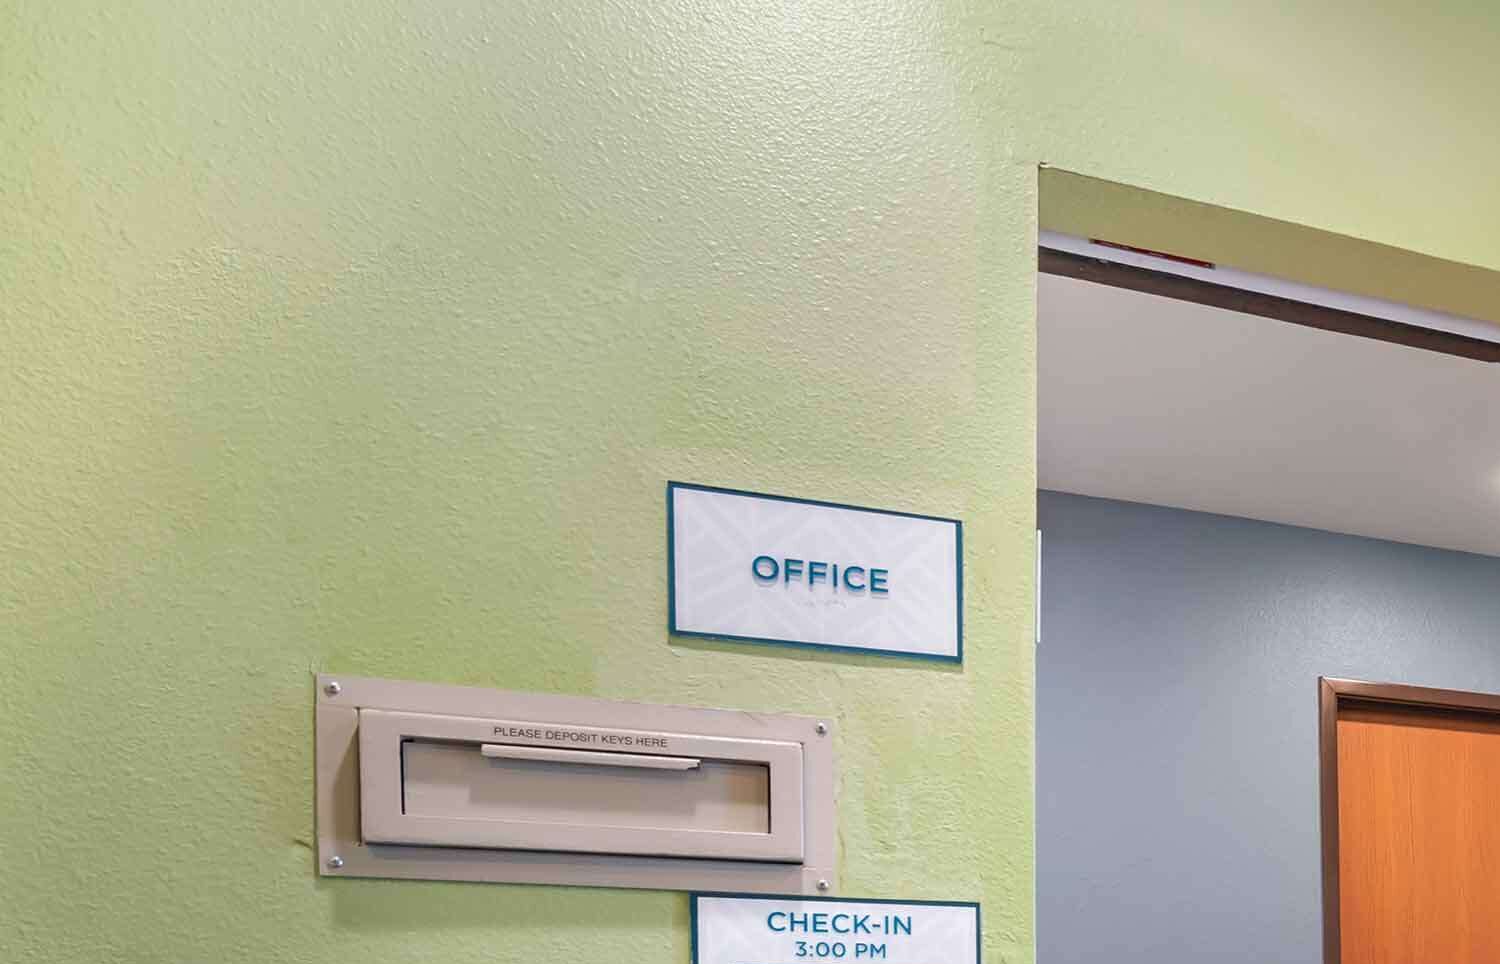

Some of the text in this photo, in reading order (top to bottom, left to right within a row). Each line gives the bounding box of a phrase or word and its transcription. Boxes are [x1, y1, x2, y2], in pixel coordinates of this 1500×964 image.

[752, 555, 889, 594] OFFICE
[493, 726, 668, 748] PLEASE DEPOSIT KEYS HERE
[766, 911, 913, 935] CHECK-IN
[794, 941, 887, 959] 3:00 PM
